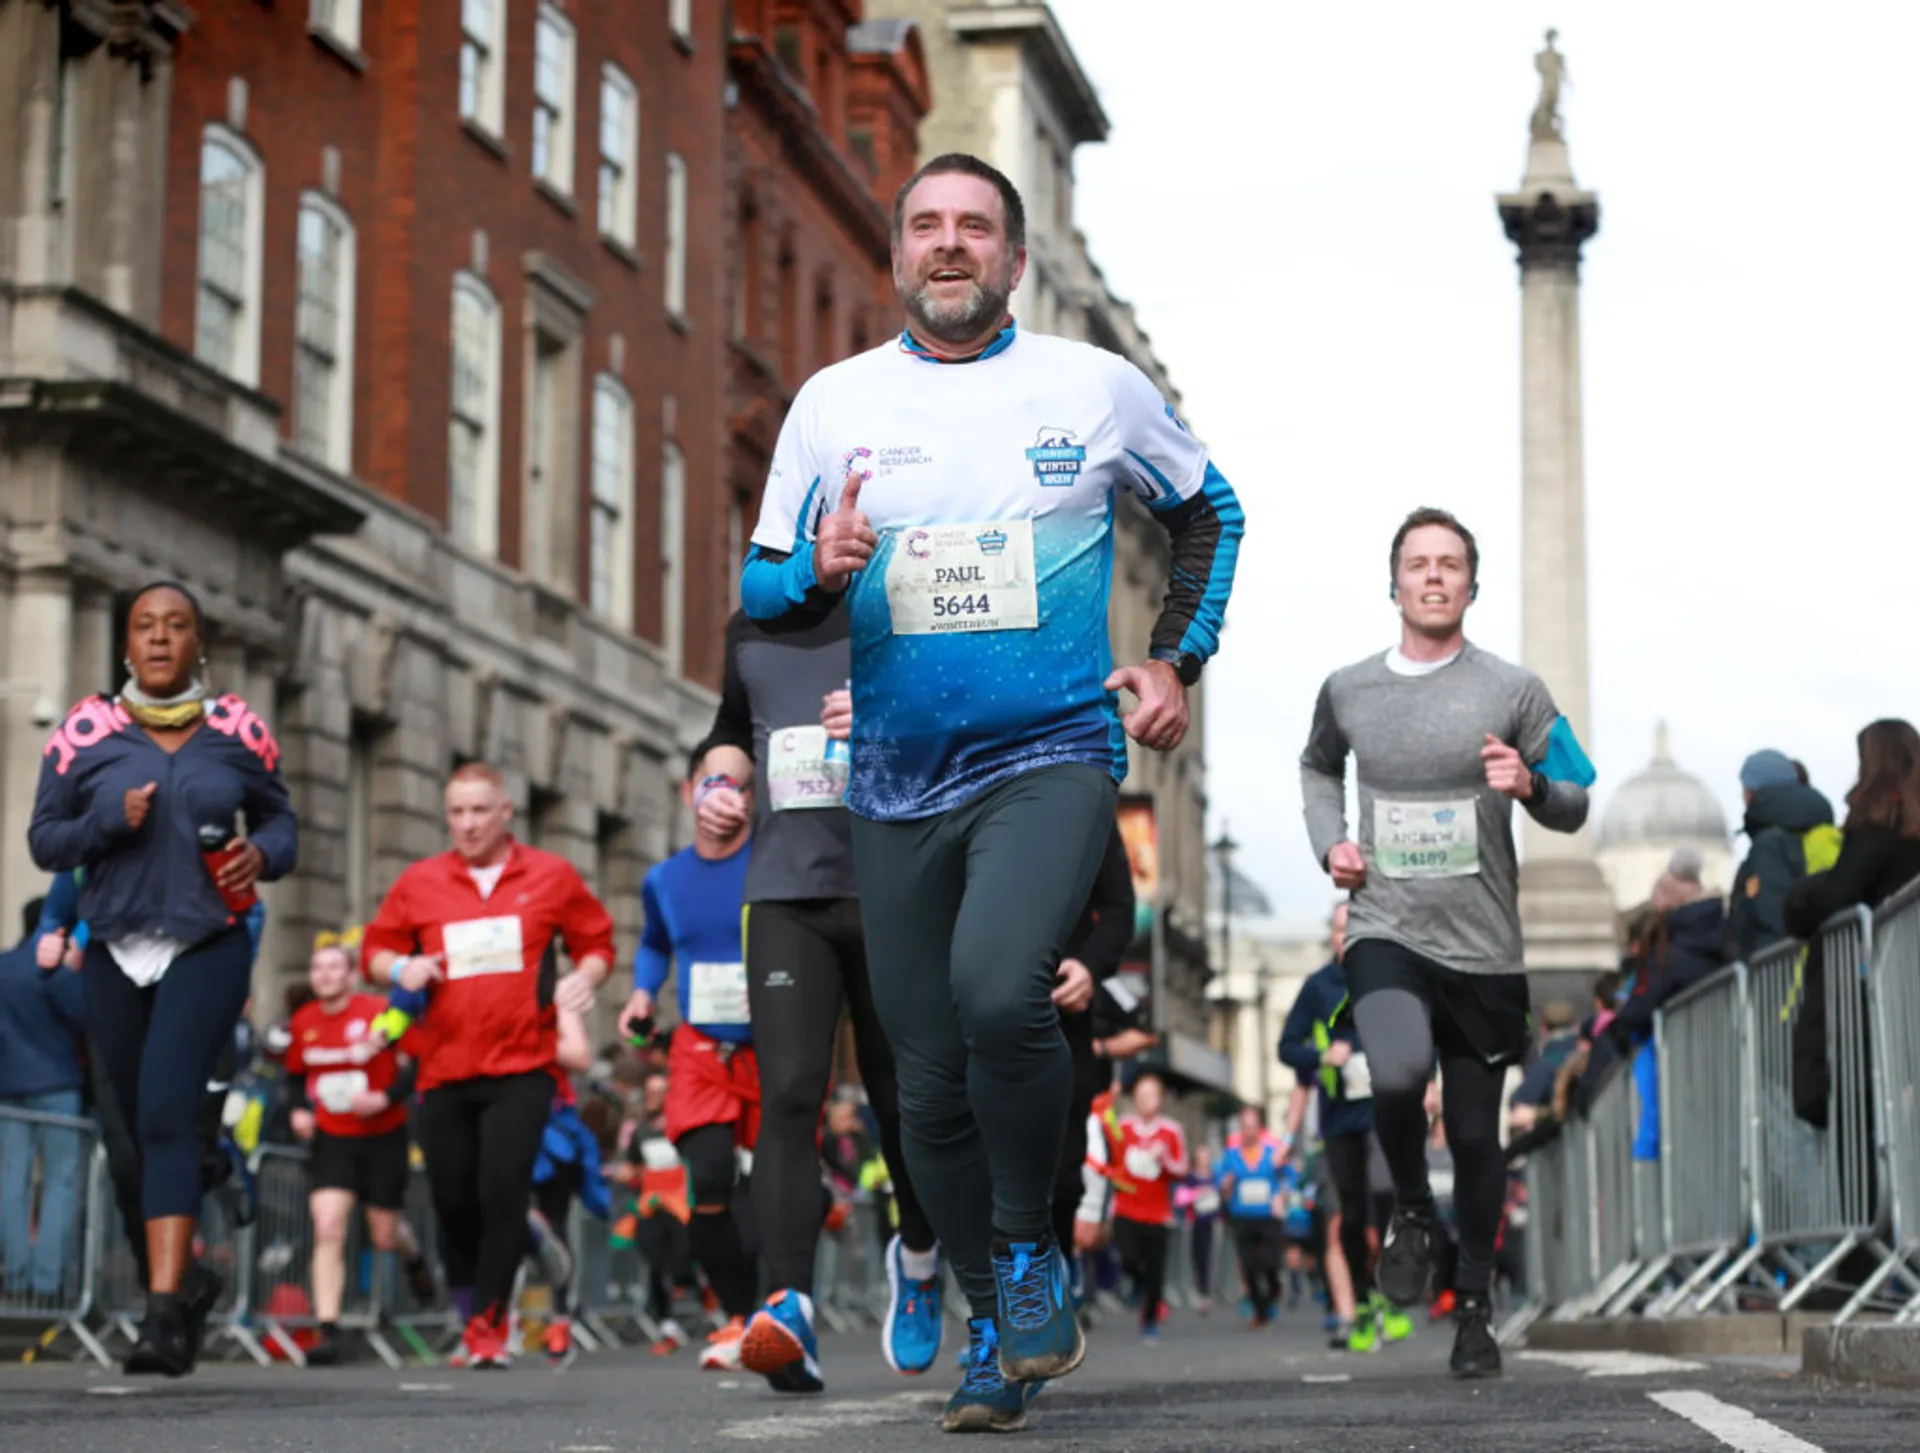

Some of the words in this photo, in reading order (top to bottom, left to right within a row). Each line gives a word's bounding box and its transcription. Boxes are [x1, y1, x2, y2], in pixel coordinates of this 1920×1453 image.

[1038, 461, 1078, 472] WINTER
[934, 566, 986, 583] PAUL
[933, 594, 992, 617] 5644
